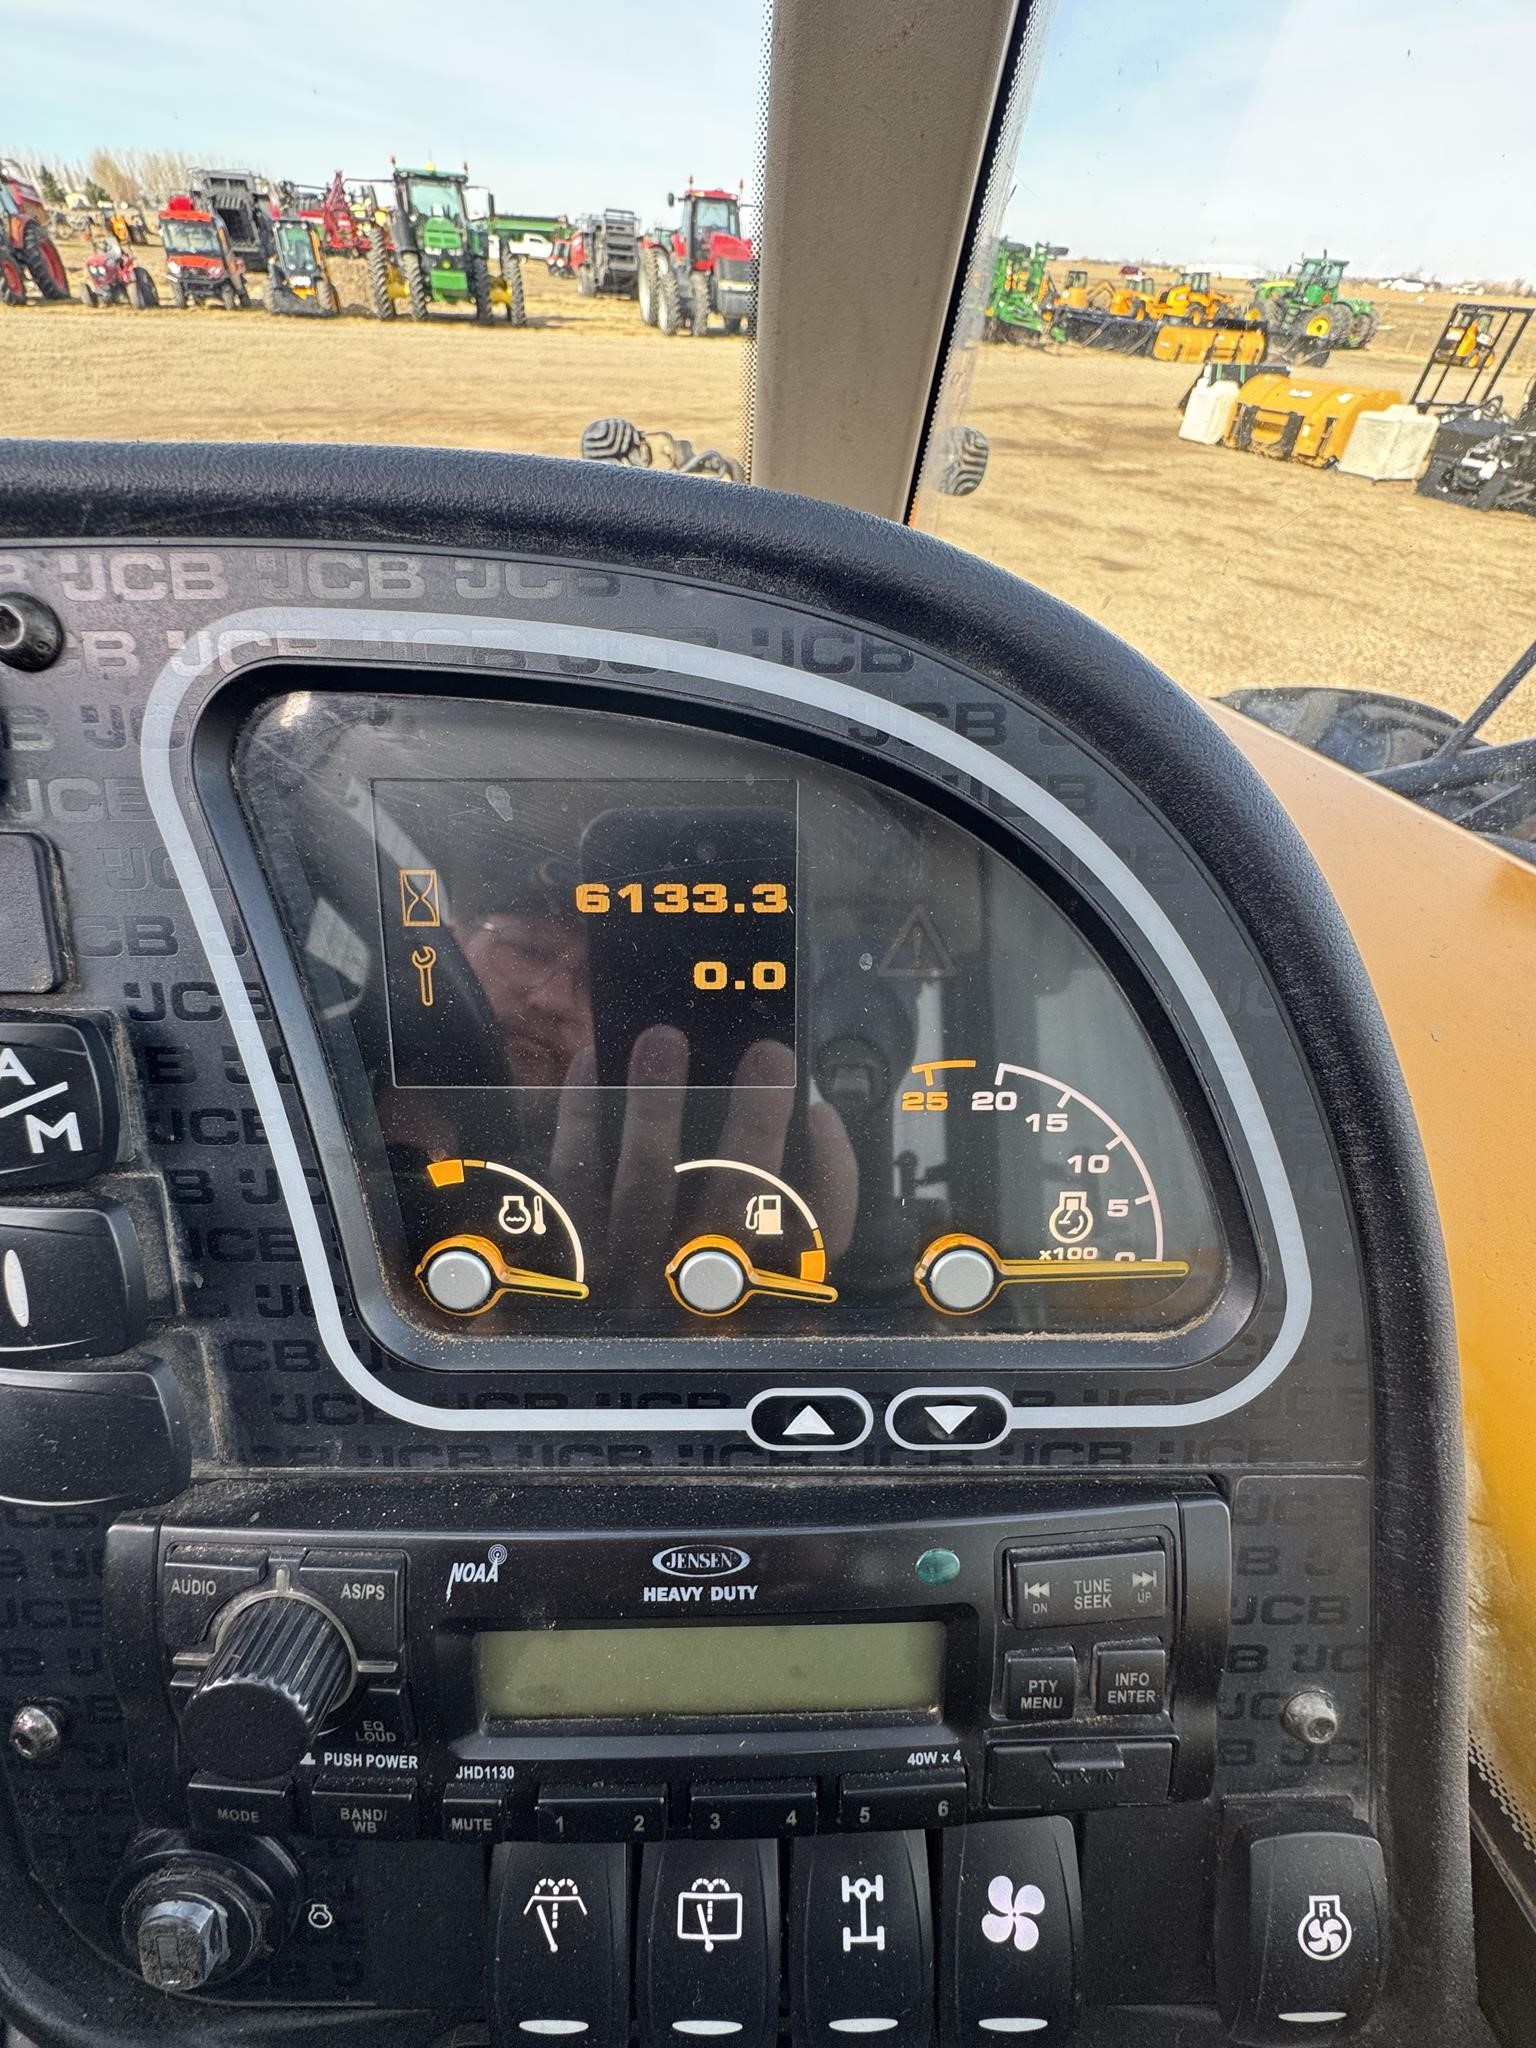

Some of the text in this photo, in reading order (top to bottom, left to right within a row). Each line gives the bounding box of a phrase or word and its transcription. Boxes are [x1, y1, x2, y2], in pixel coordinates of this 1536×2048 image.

[58, 552, 229, 601] JCB
[255, 552, 425, 600] JCB
[575, 883, 788, 914] 6133.3
[693, 961, 787, 990] 0.0
[902, 1091, 949, 1112] 25
[971, 1091, 1018, 1112] 20
[1025, 1113, 1069, 1133] 15
[25, 1111, 83, 1154] M
[1067, 1154, 1110, 1174] 10
[1107, 1199, 1130, 1218] 5
[1039, 1247, 1098, 1261] x100
[666, 1552, 733, 1570] JENSEN
[171, 1578, 217, 1596] AUDIO
[446, 1560, 499, 1602] NOAA
[1074, 1578, 1112, 1595] TUNE
[340, 1583, 385, 1600] AS/PS
[644, 1585, 759, 1602] HEAVY DUTY
[1137, 1592, 1151, 1604] UP
[1032, 1603, 1048, 1614] DN
[1074, 1594, 1112, 1611] SEEK
[1028, 1680, 1058, 1693] PTY
[1115, 1672, 1150, 1687] INFO
[1020, 1697, 1063, 1710] MENU
[1107, 1690, 1156, 1705] ENTER
[363, 1720, 385, 1732] EQ
[355, 1731, 396, 1743] LOUD
[324, 1752, 419, 1769] PUSH POWER
[907, 1749, 962, 1766] 40W x 4
[455, 1765, 515, 1781] JHD1130
[217, 1808, 260, 1823] MODE
[340, 1807, 387, 1821] BAND/
[859, 1806, 871, 1824] 5
[937, 1800, 949, 1818] 6
[451, 1816, 493, 1832] MUTE
[555, 1816, 564, 1833] 1
[634, 1814, 645, 1831] 2
[710, 1813, 721, 1830] 3
[786, 1810, 797, 1827] 4
[353, 1821, 378, 1834] WB
